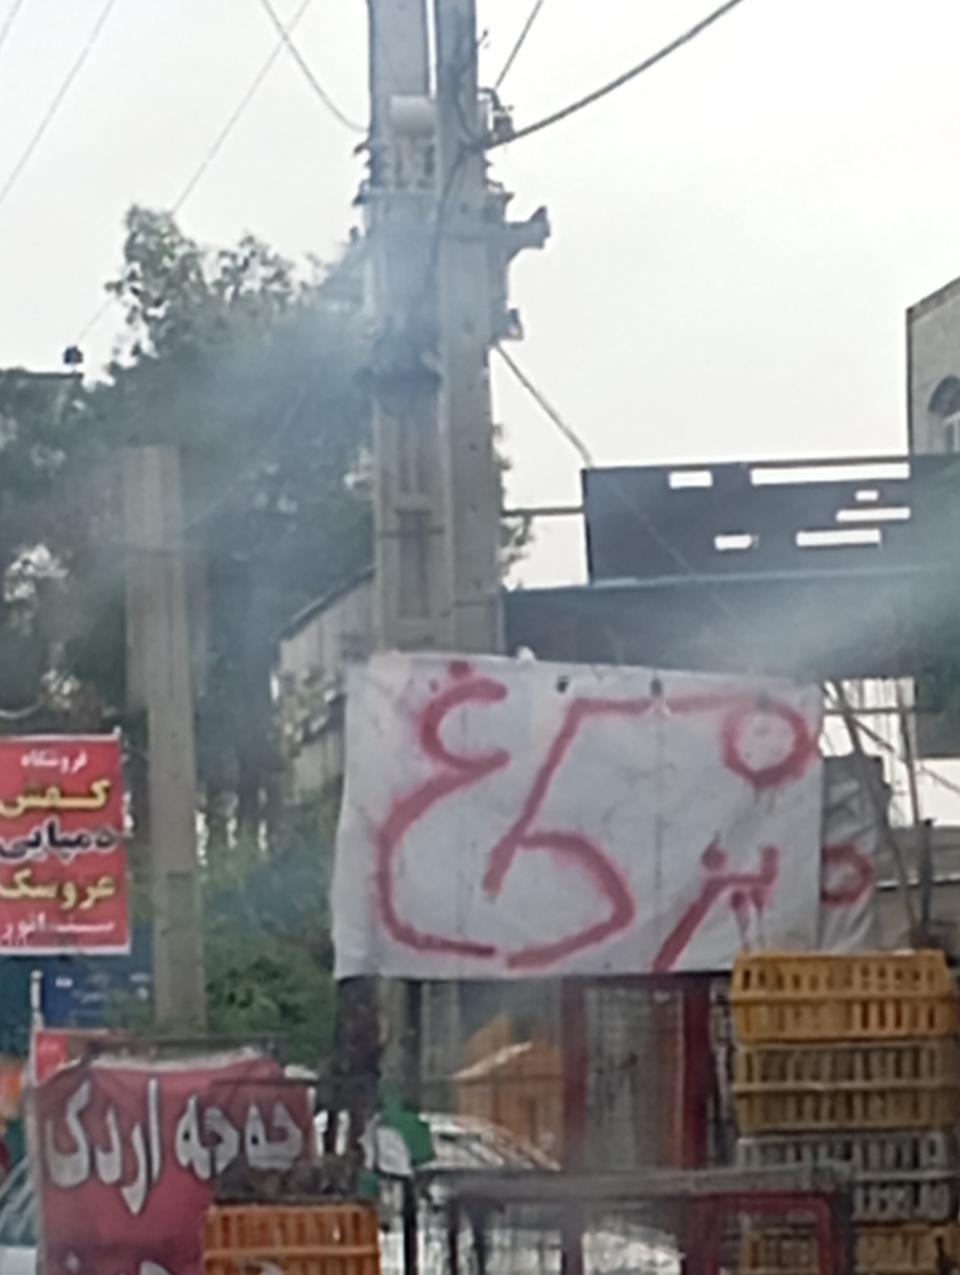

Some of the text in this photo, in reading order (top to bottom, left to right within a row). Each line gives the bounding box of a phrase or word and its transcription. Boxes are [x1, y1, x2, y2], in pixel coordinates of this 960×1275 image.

[20, 749, 88, 773] فروشگاه
[0, 867, 116, 911] عروسک
[44, 1076, 162, 1216] اردک
